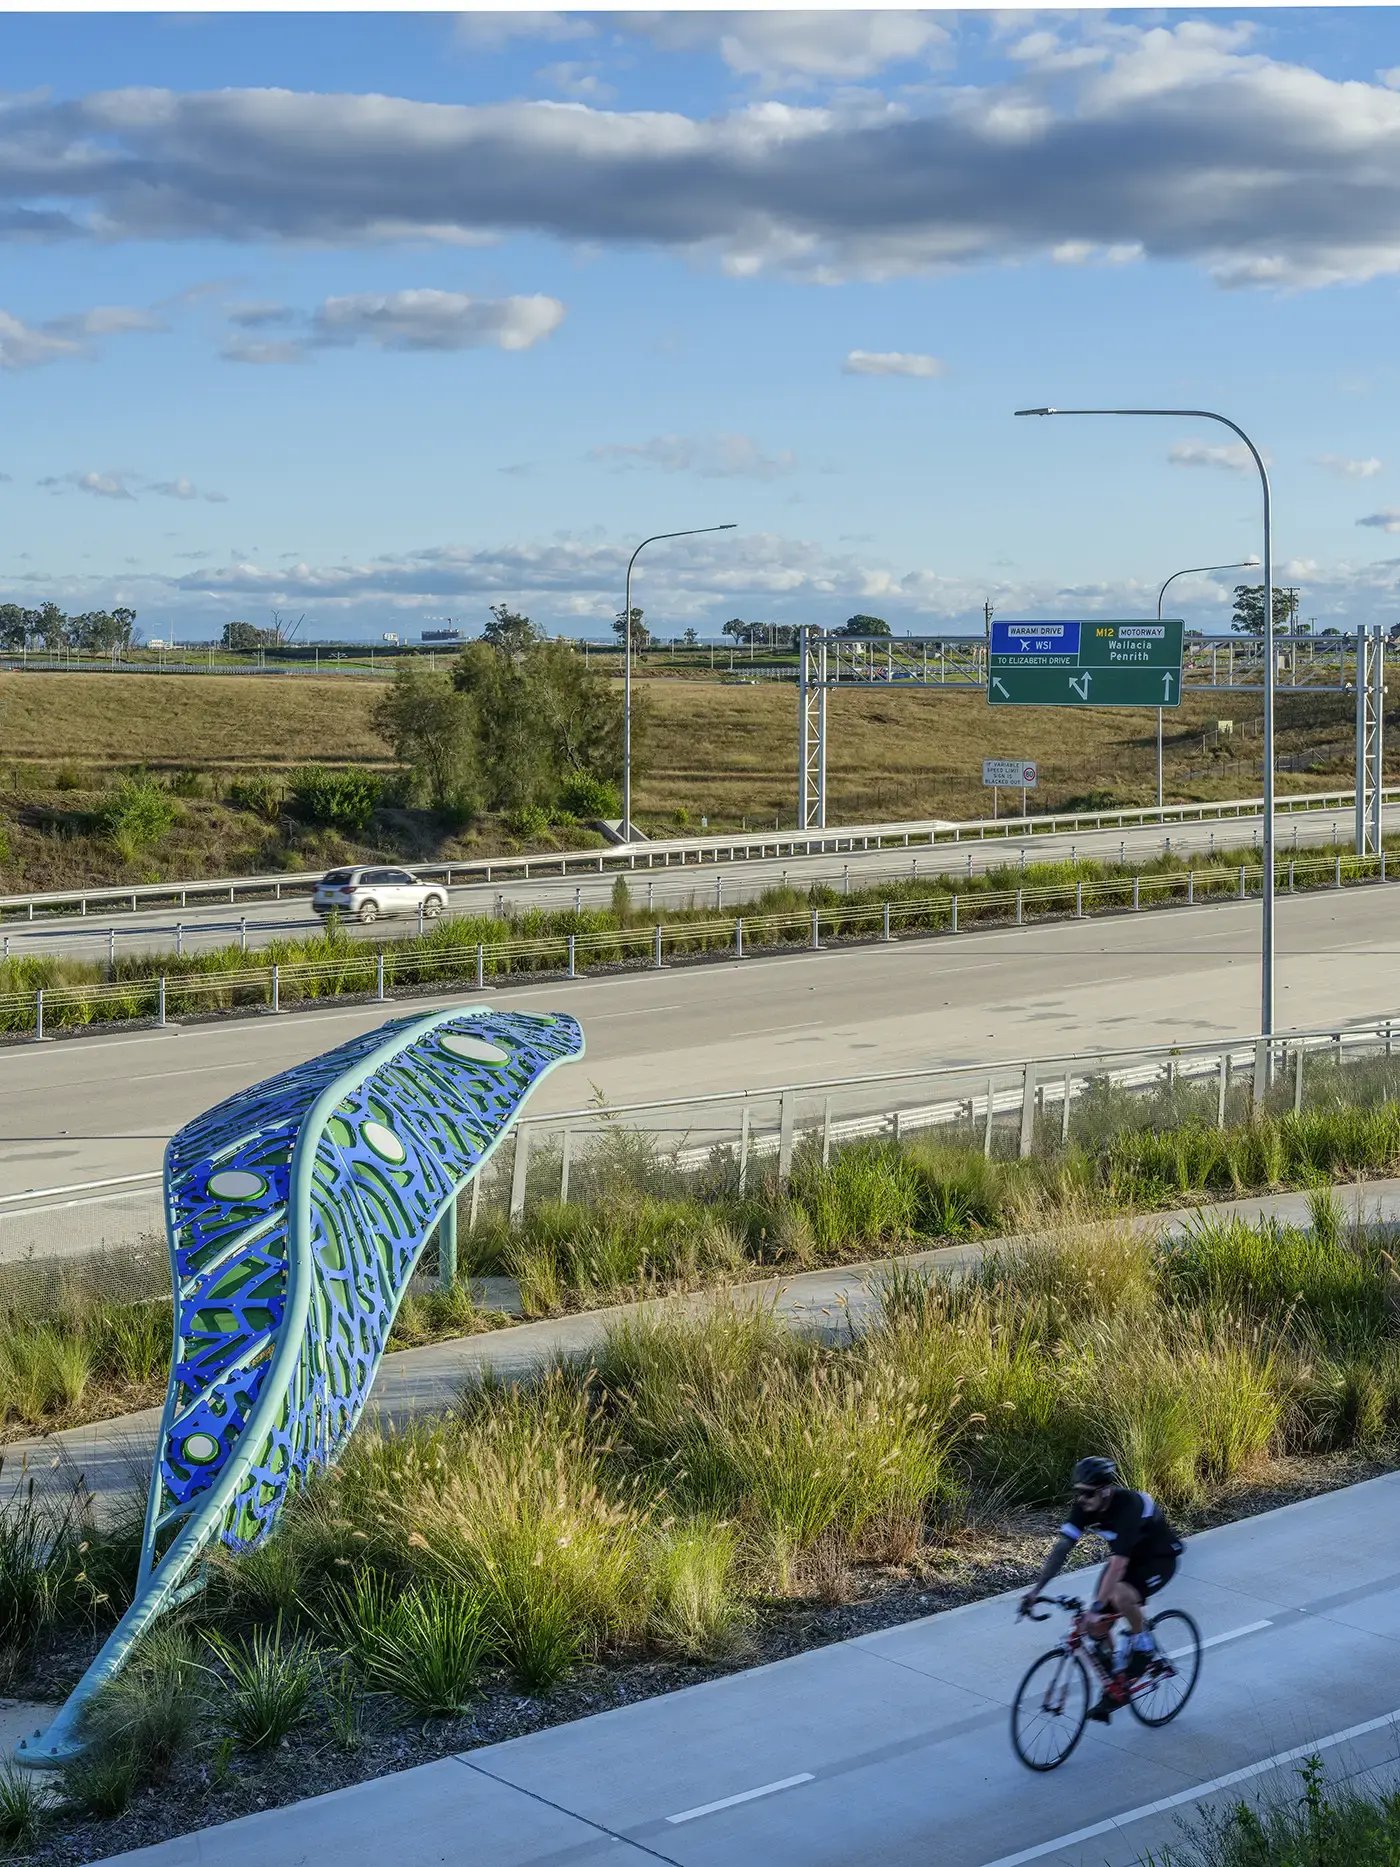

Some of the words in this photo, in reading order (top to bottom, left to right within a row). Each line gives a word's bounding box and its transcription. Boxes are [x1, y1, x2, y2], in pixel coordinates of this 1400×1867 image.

[1010, 627, 1039, 635] WARAMI
[1040, 627, 1062, 635] DRIVE
[1095, 628, 1114, 637] M12
[1120, 628, 1163, 636] MOTORWAY
[1035, 641, 1052, 650] WSI
[1108, 640, 1152, 650] Wallacia
[1110, 651, 1149, 661] Penrith
